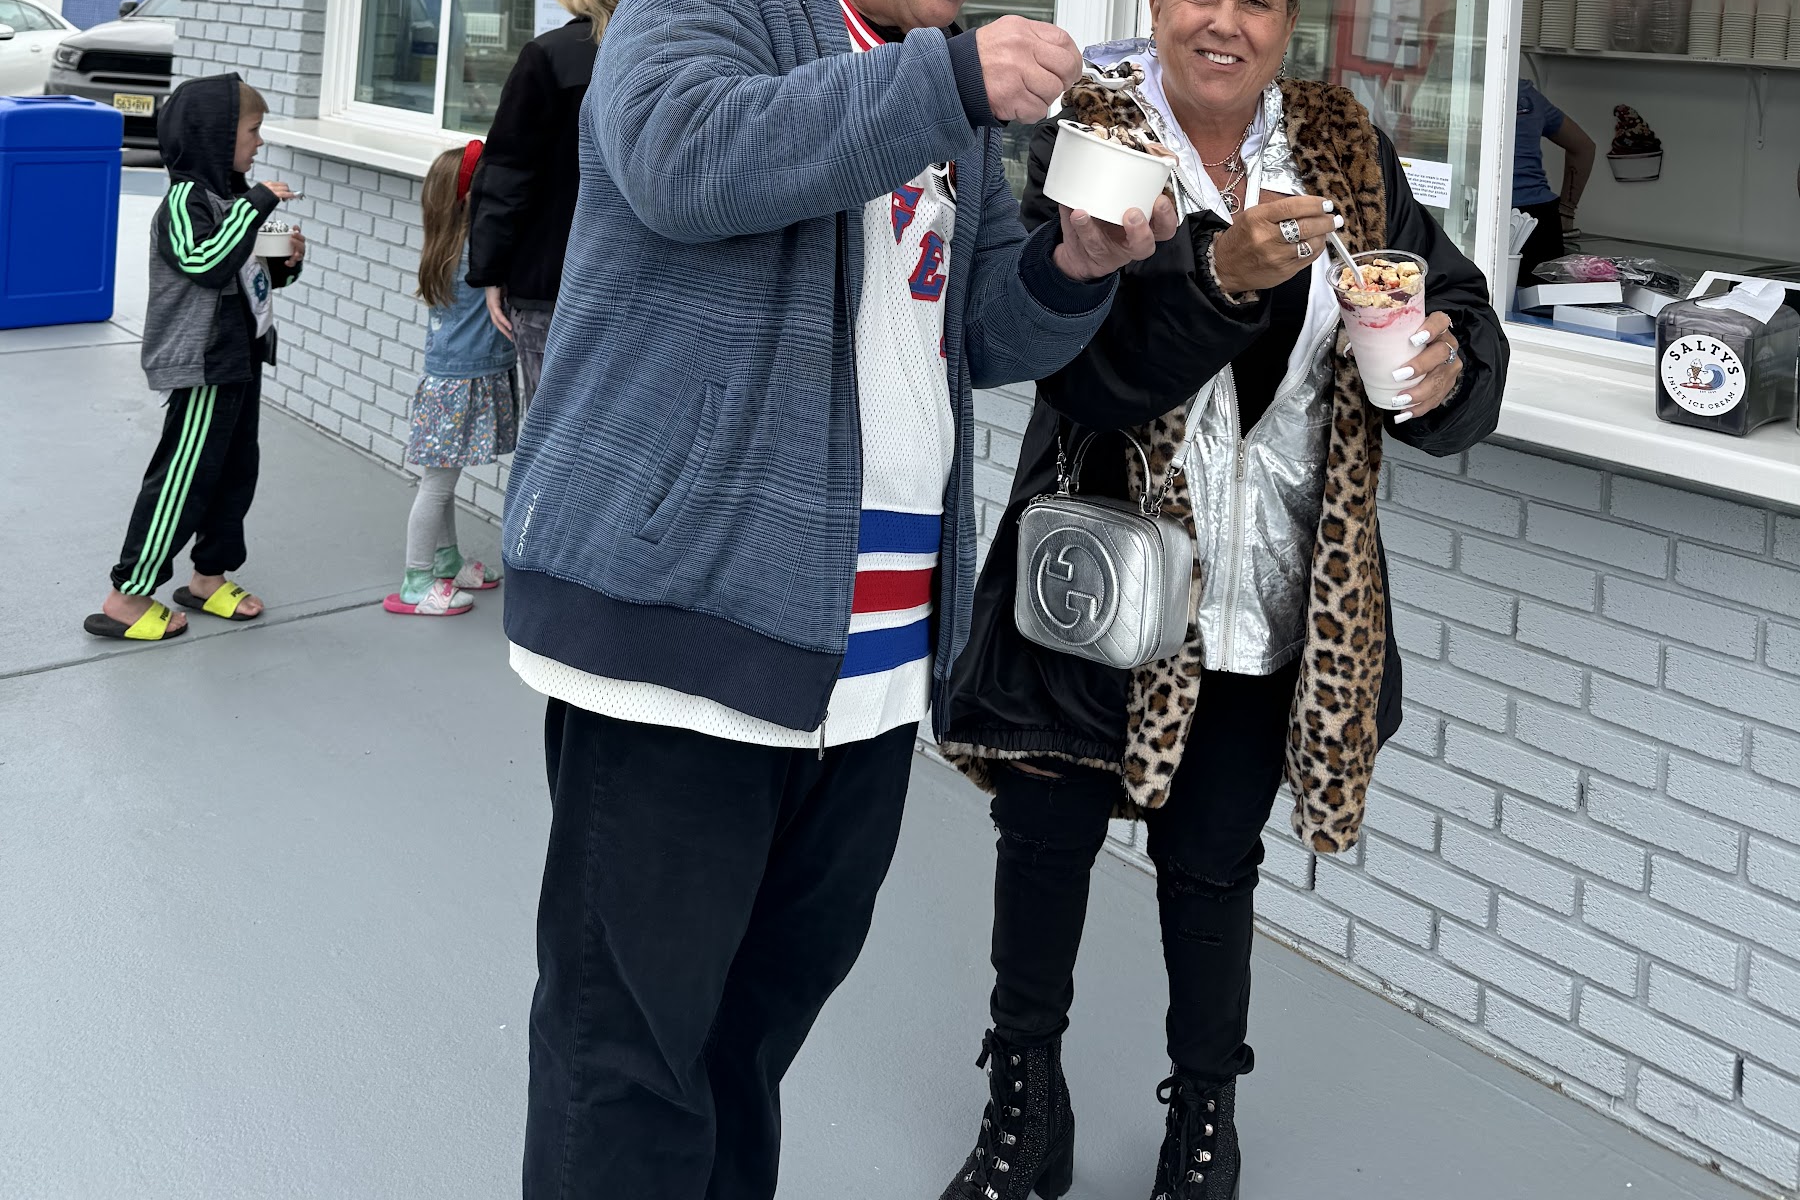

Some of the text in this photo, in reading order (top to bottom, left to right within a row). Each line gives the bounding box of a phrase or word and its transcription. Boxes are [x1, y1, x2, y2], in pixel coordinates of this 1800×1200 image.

[1669, 340, 1740, 375] SALTY'S
[1667, 376, 1736, 410] INLET ICE CREAM
